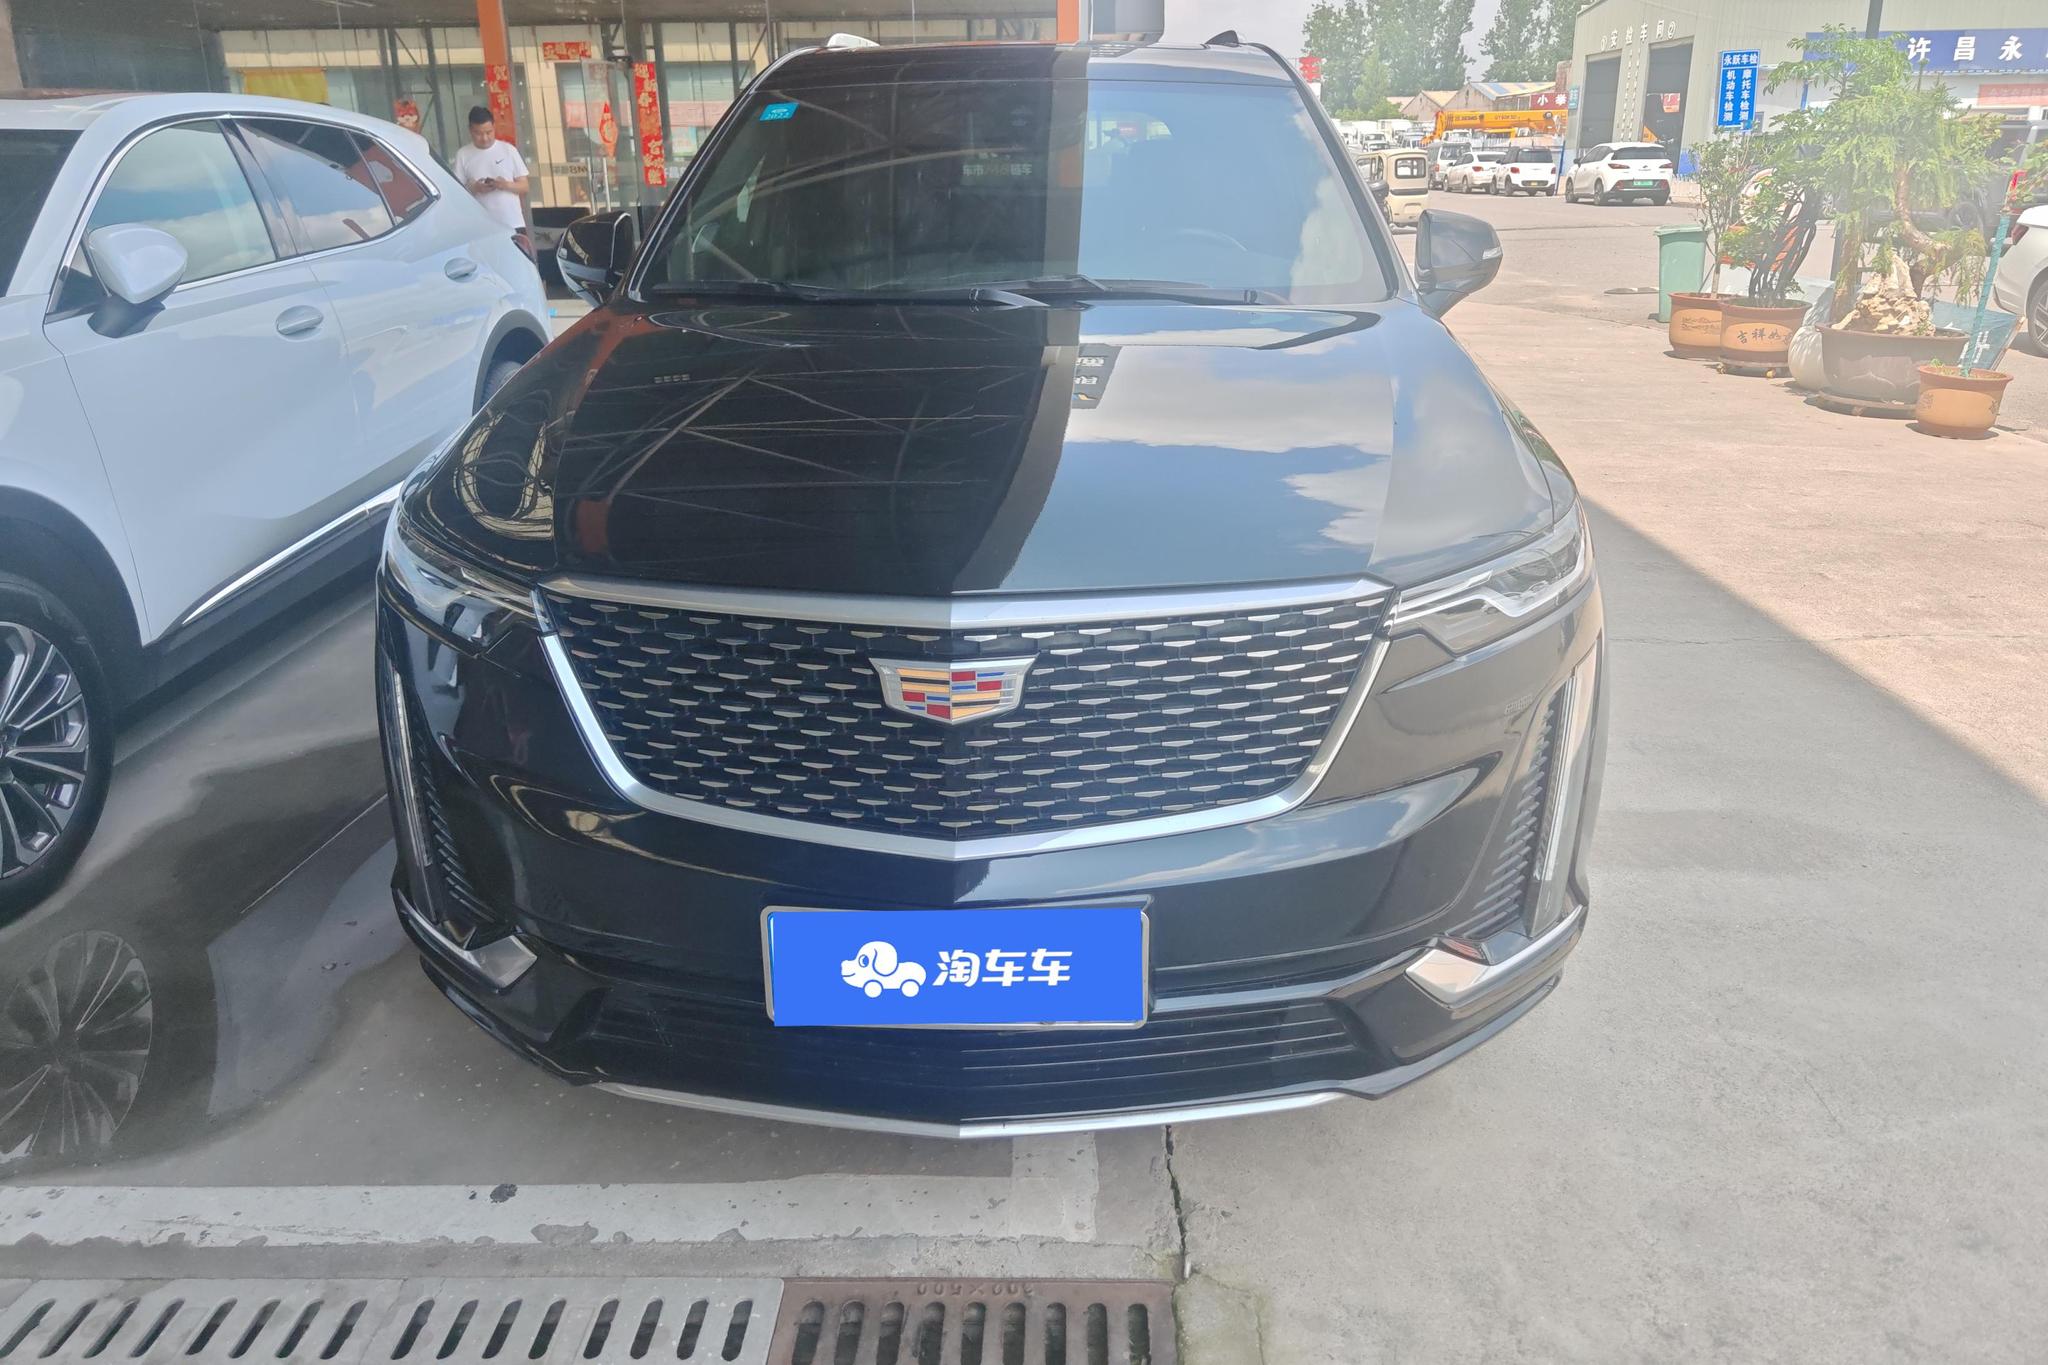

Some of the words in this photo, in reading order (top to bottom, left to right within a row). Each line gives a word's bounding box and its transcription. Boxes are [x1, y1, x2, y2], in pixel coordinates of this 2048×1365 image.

[1723, 54, 1758, 66] 永跃车检
[1907, 35, 2048, 62] 许昌永
[1722, 69, 1737, 122] 机动车检测
[1738, 68, 1753, 121] 摩托车检测
